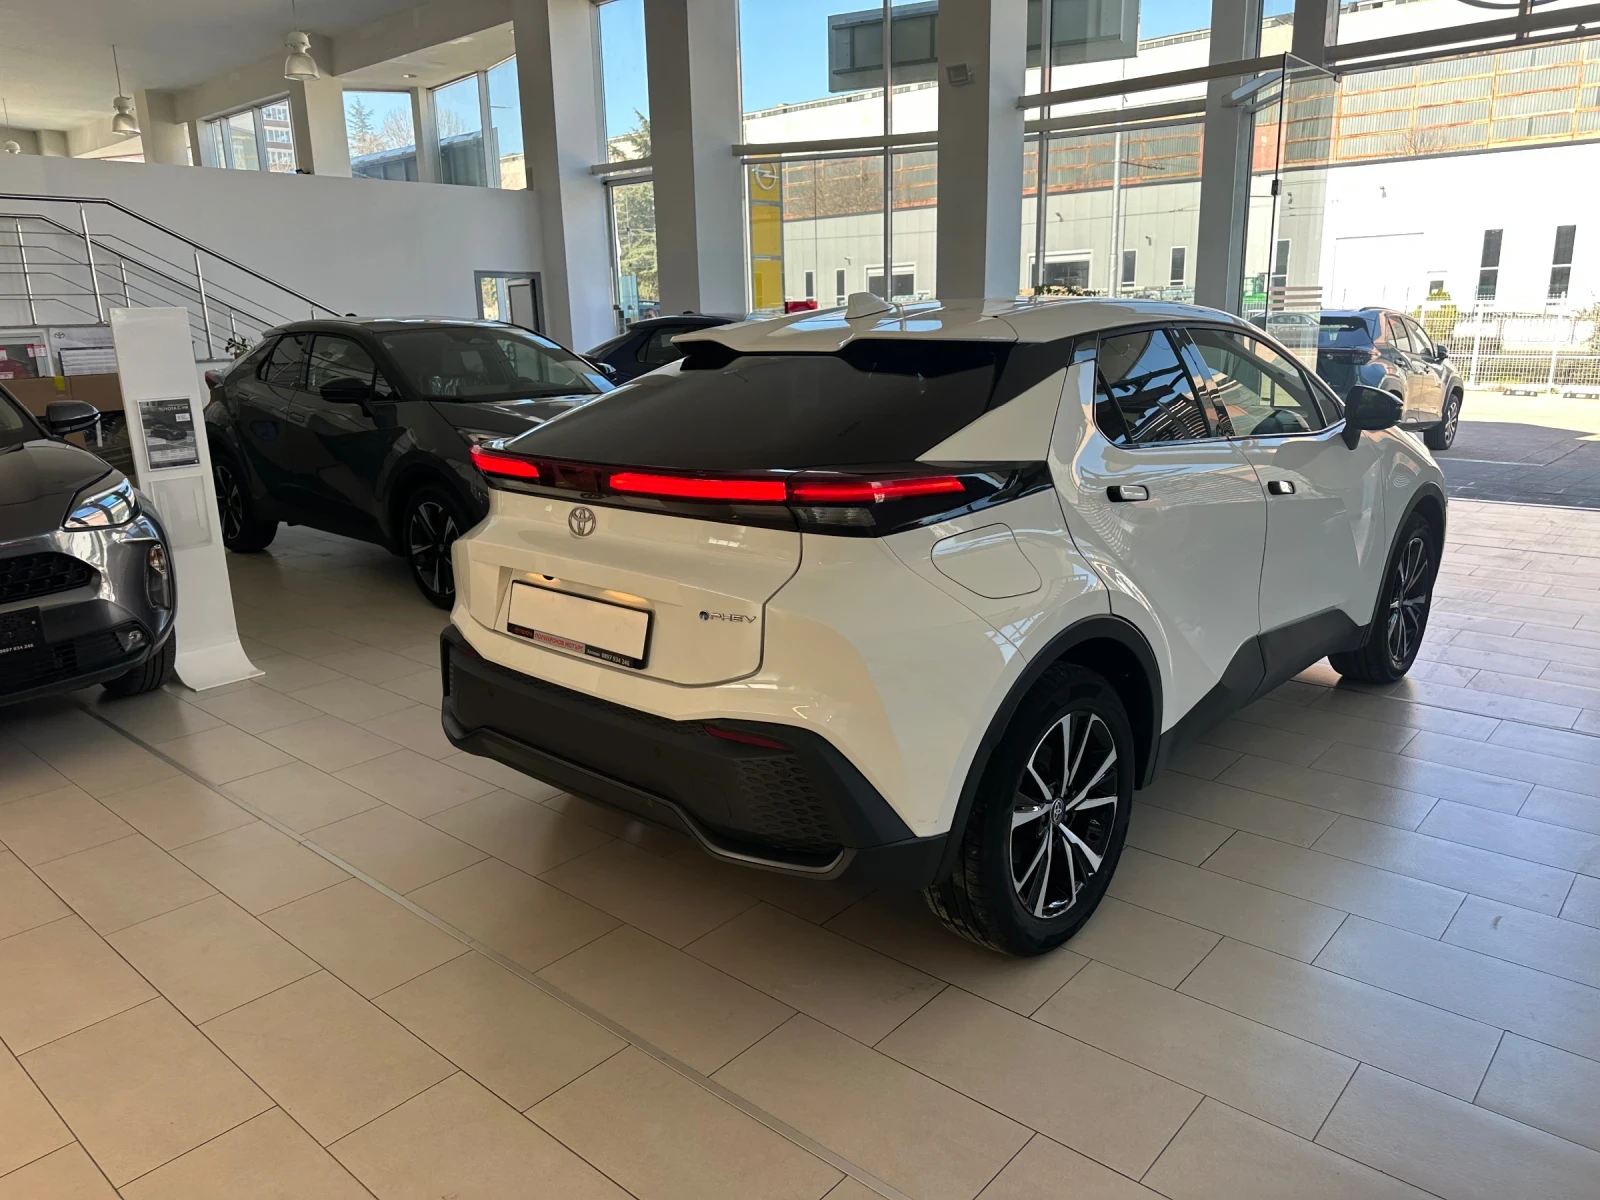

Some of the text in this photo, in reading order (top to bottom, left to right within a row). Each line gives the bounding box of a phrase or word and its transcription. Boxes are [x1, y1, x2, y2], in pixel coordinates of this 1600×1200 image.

[710, 612, 757, 624] PHEV
[601, 652, 612, 660] 0897
[612, 656, 621, 664] 934
